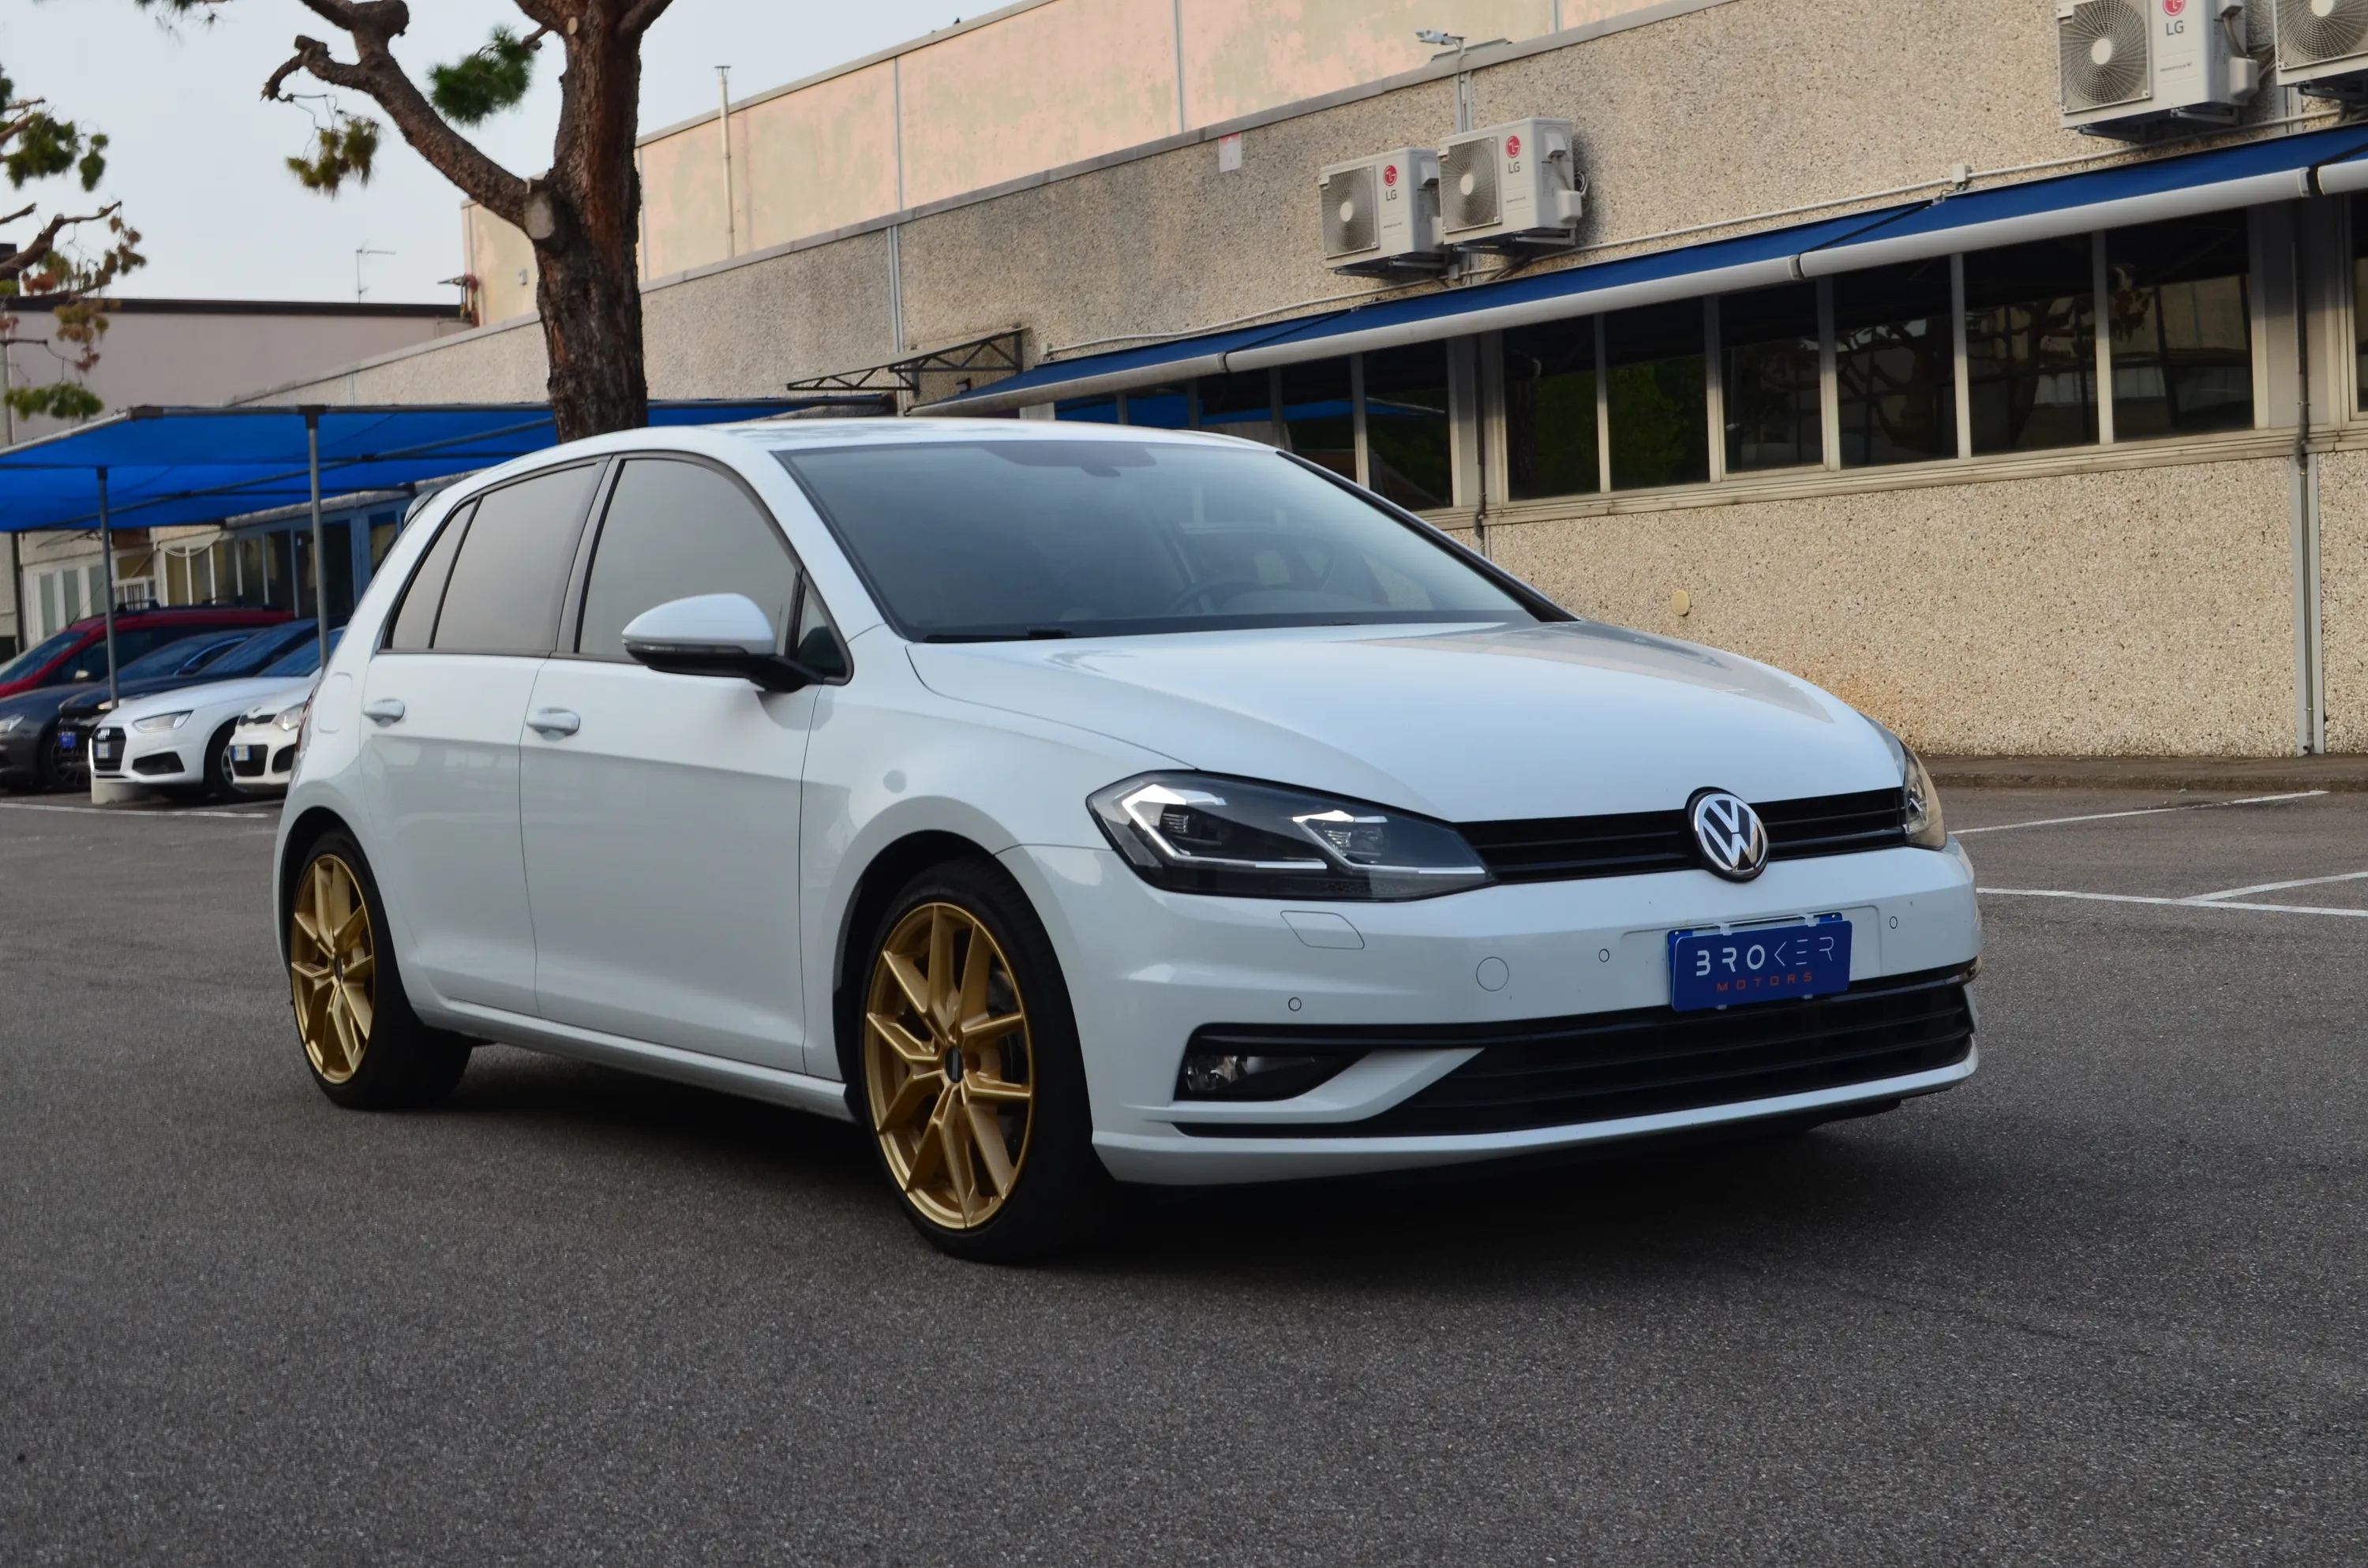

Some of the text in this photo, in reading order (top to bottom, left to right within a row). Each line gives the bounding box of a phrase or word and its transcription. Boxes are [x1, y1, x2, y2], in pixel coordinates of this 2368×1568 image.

[2166, 20, 2184, 36] LG
[1508, 161, 1520, 174] LG
[1385, 189, 1397, 201] LG
[1697, 795, 1763, 872] VW
[1696, 936, 1834, 976] BROKER
[1716, 972, 1812, 992] MOTORS
